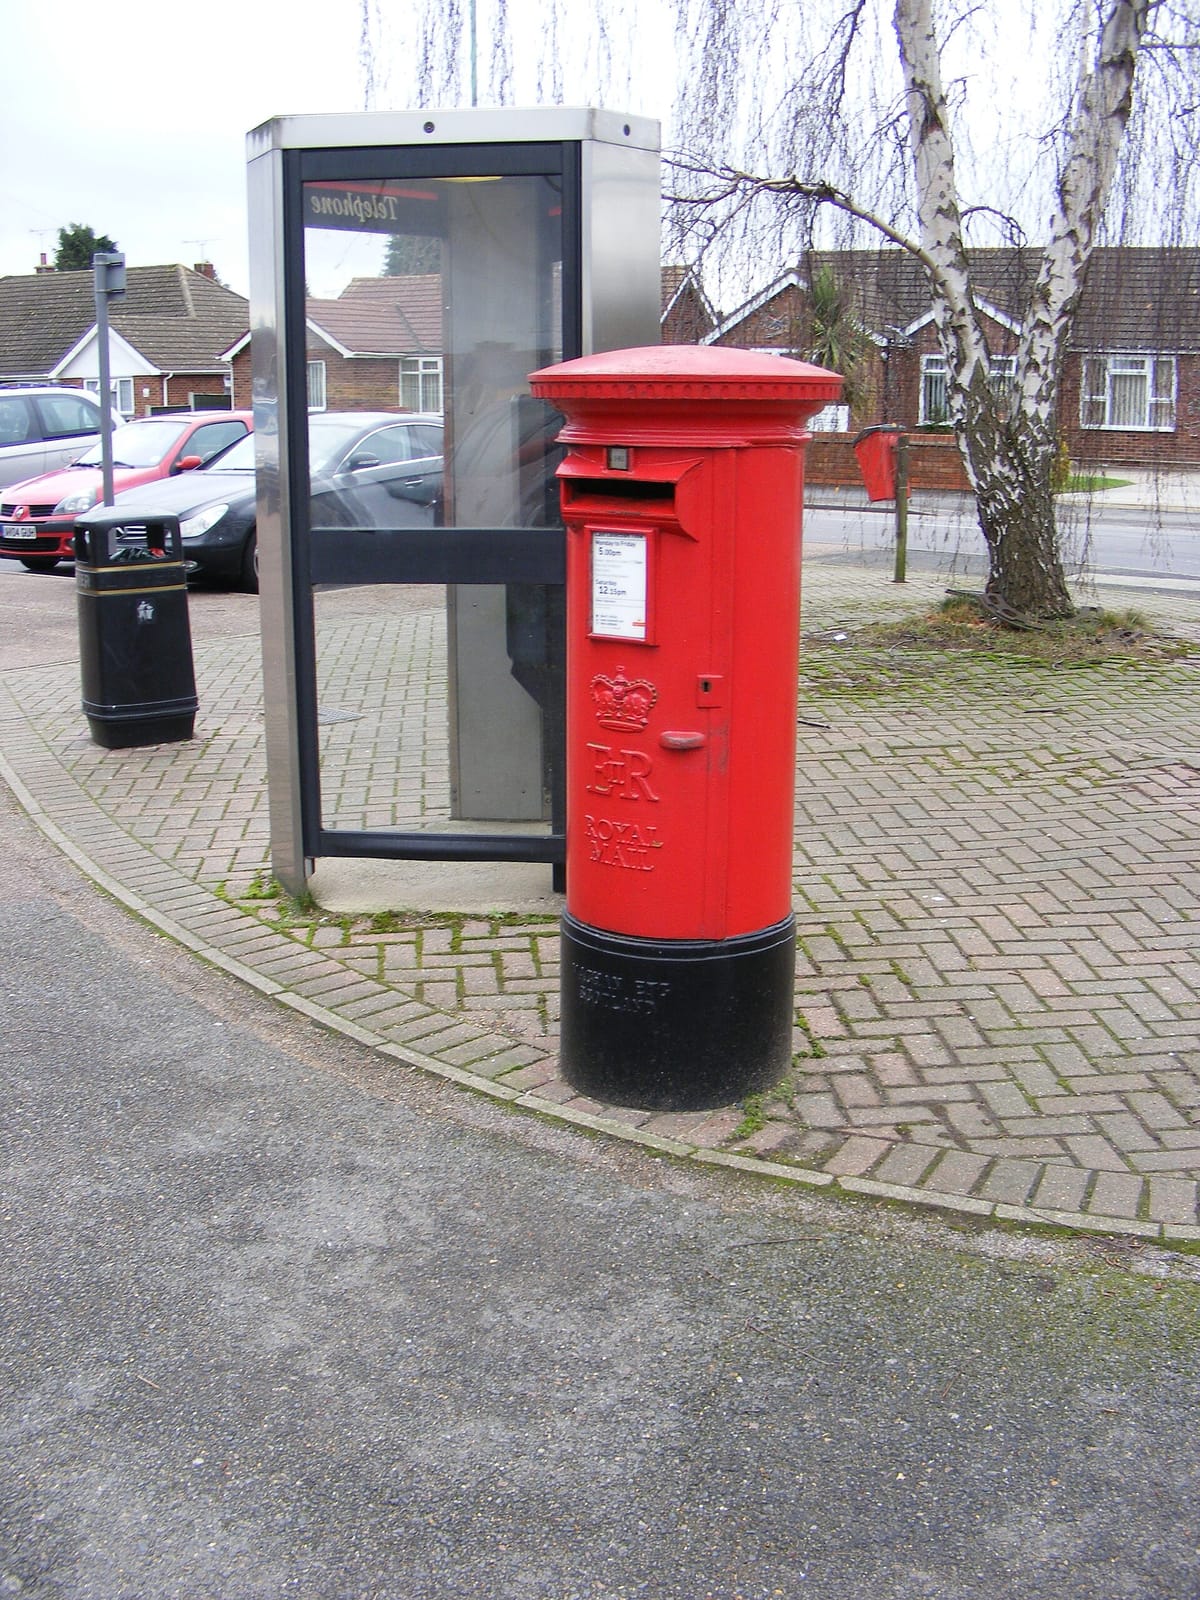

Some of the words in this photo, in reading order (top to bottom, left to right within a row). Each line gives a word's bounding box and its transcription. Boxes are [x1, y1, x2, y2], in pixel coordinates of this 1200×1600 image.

[620, 540, 636, 548] Friday
[595, 579, 617, 587] Saturday
[584, 814, 664, 848] ROYAL
[589, 840, 655, 872] MAIL
